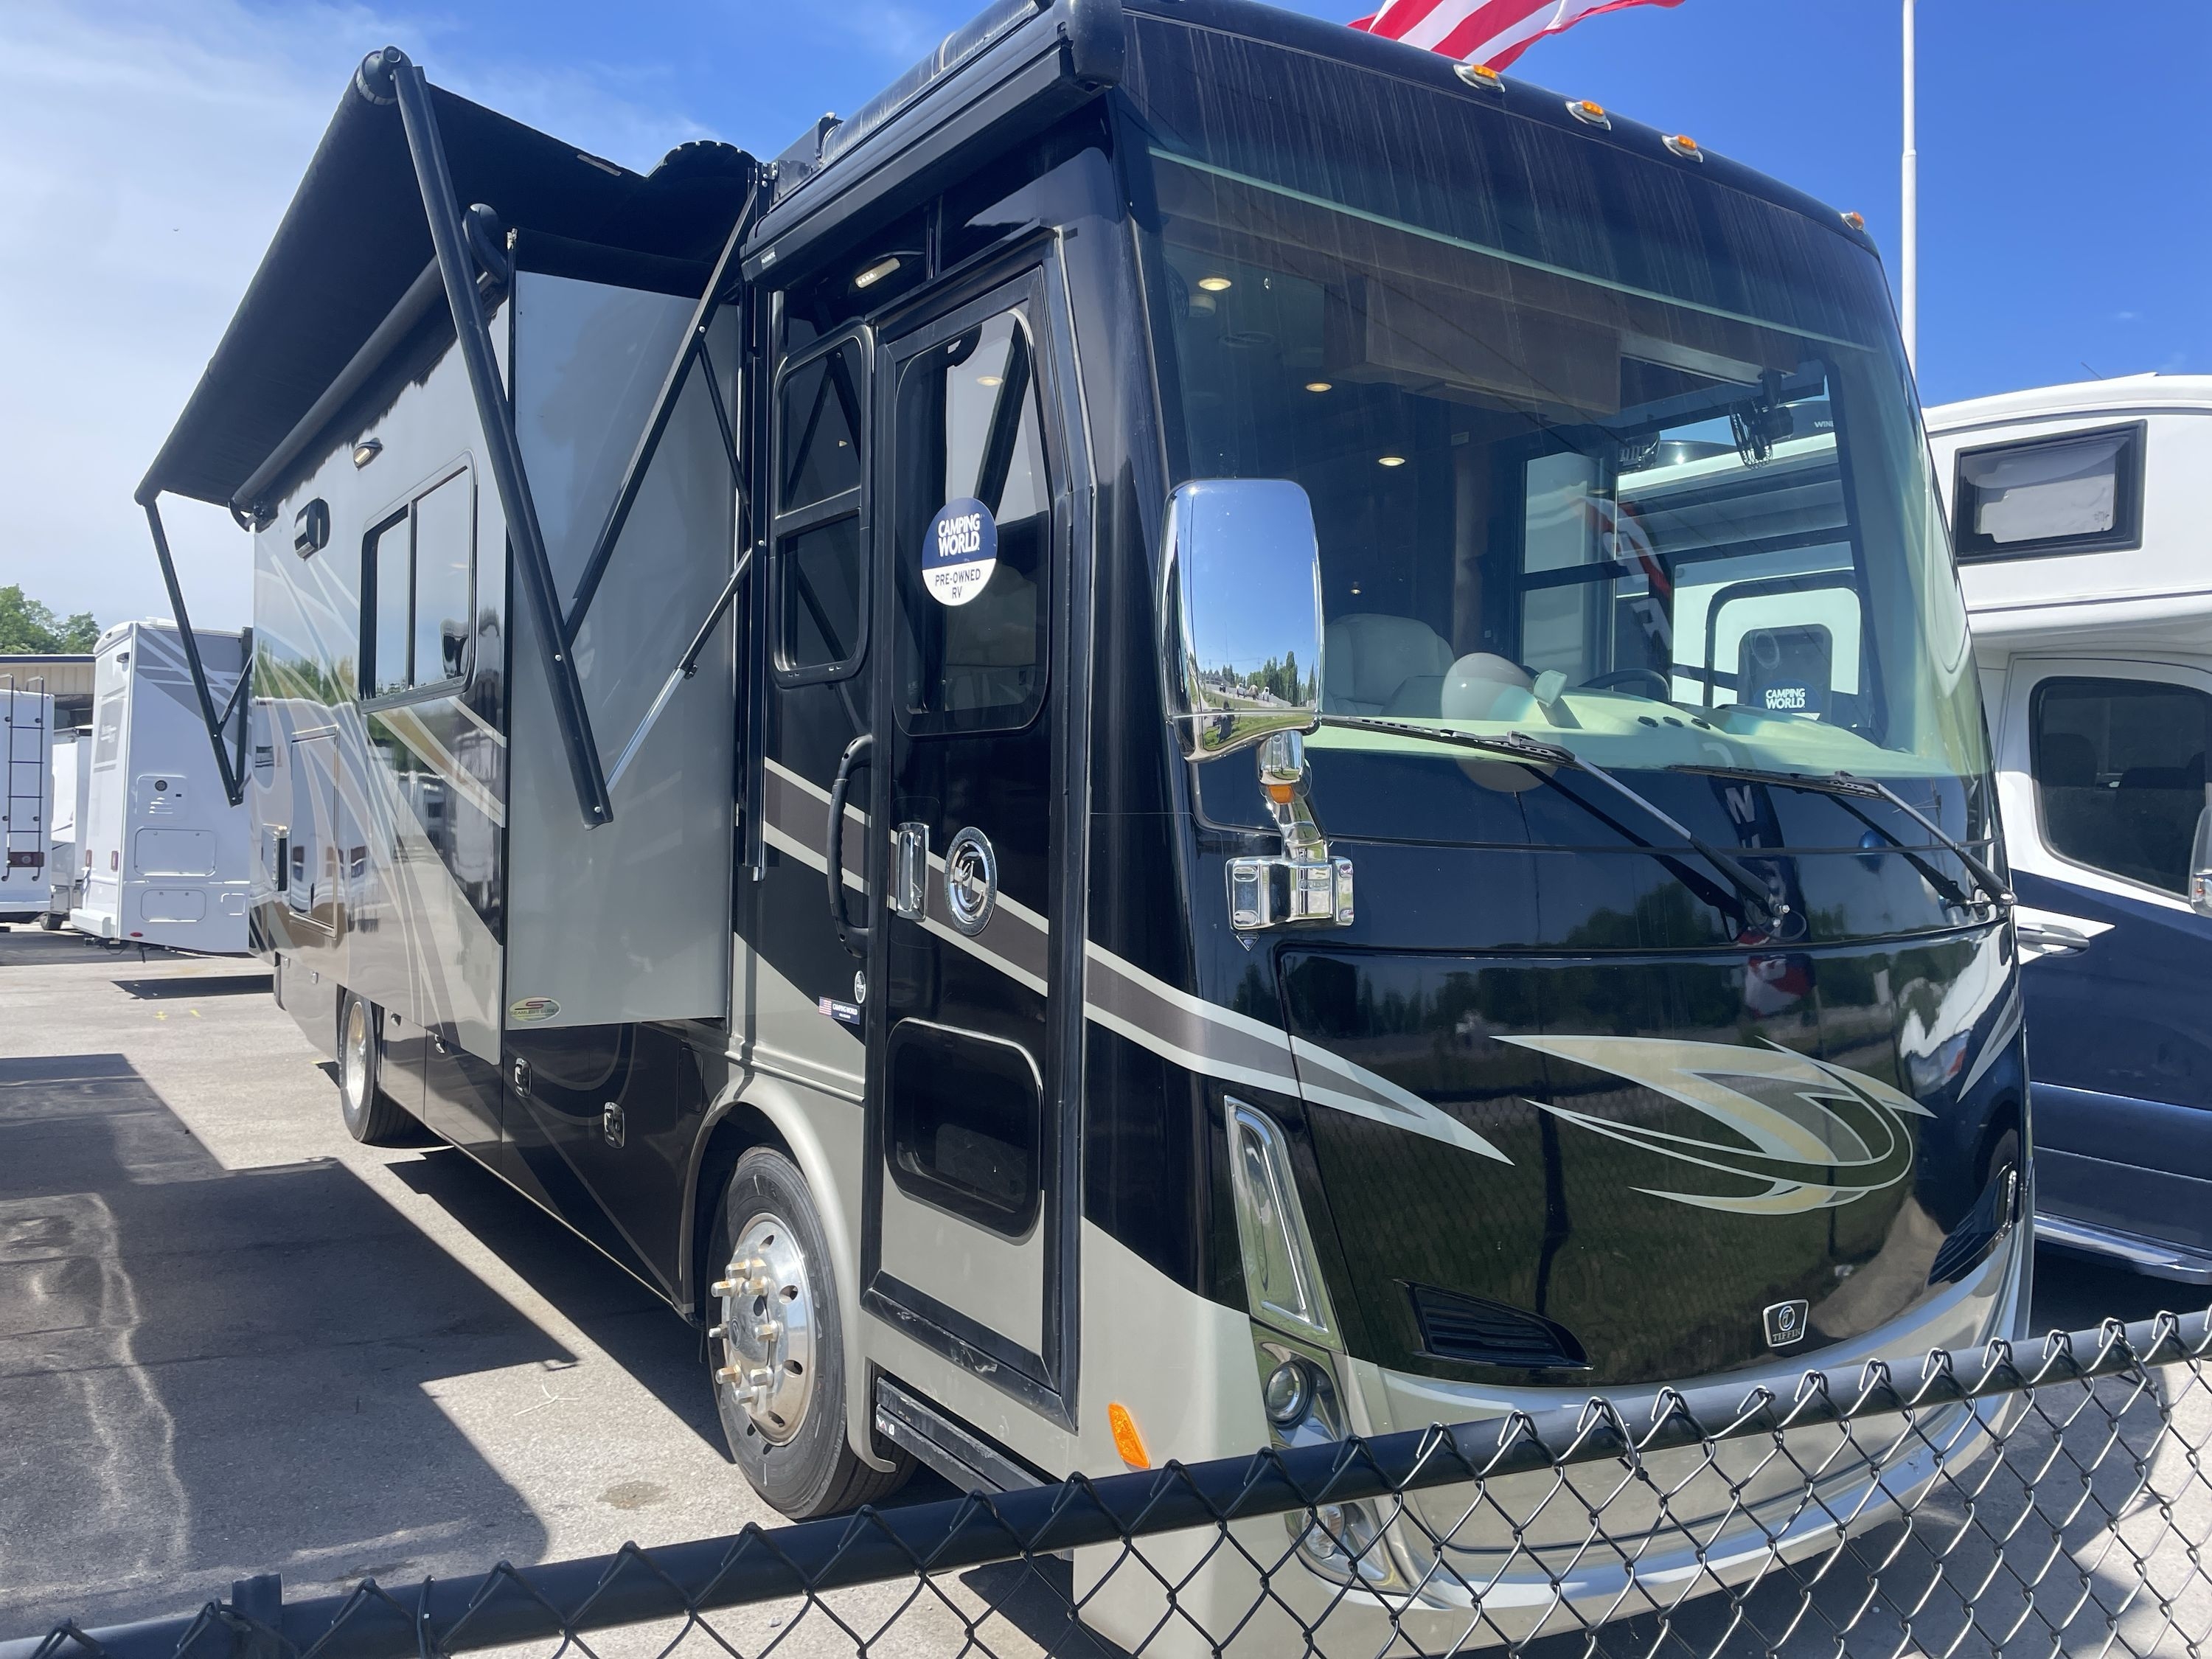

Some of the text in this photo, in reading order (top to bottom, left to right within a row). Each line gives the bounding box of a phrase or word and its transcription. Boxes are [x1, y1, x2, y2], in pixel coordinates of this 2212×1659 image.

[938, 512, 980, 538] CAMPING
[938, 531, 979, 557] WORLD
[935, 568, 981, 586] PRE-OWNED
[952, 587, 962, 599] RV
[1766, 688, 1805, 699] CAMPING
[1766, 697, 1805, 709] WORLD
[1773, 1328, 1801, 1341] TIFFIN
